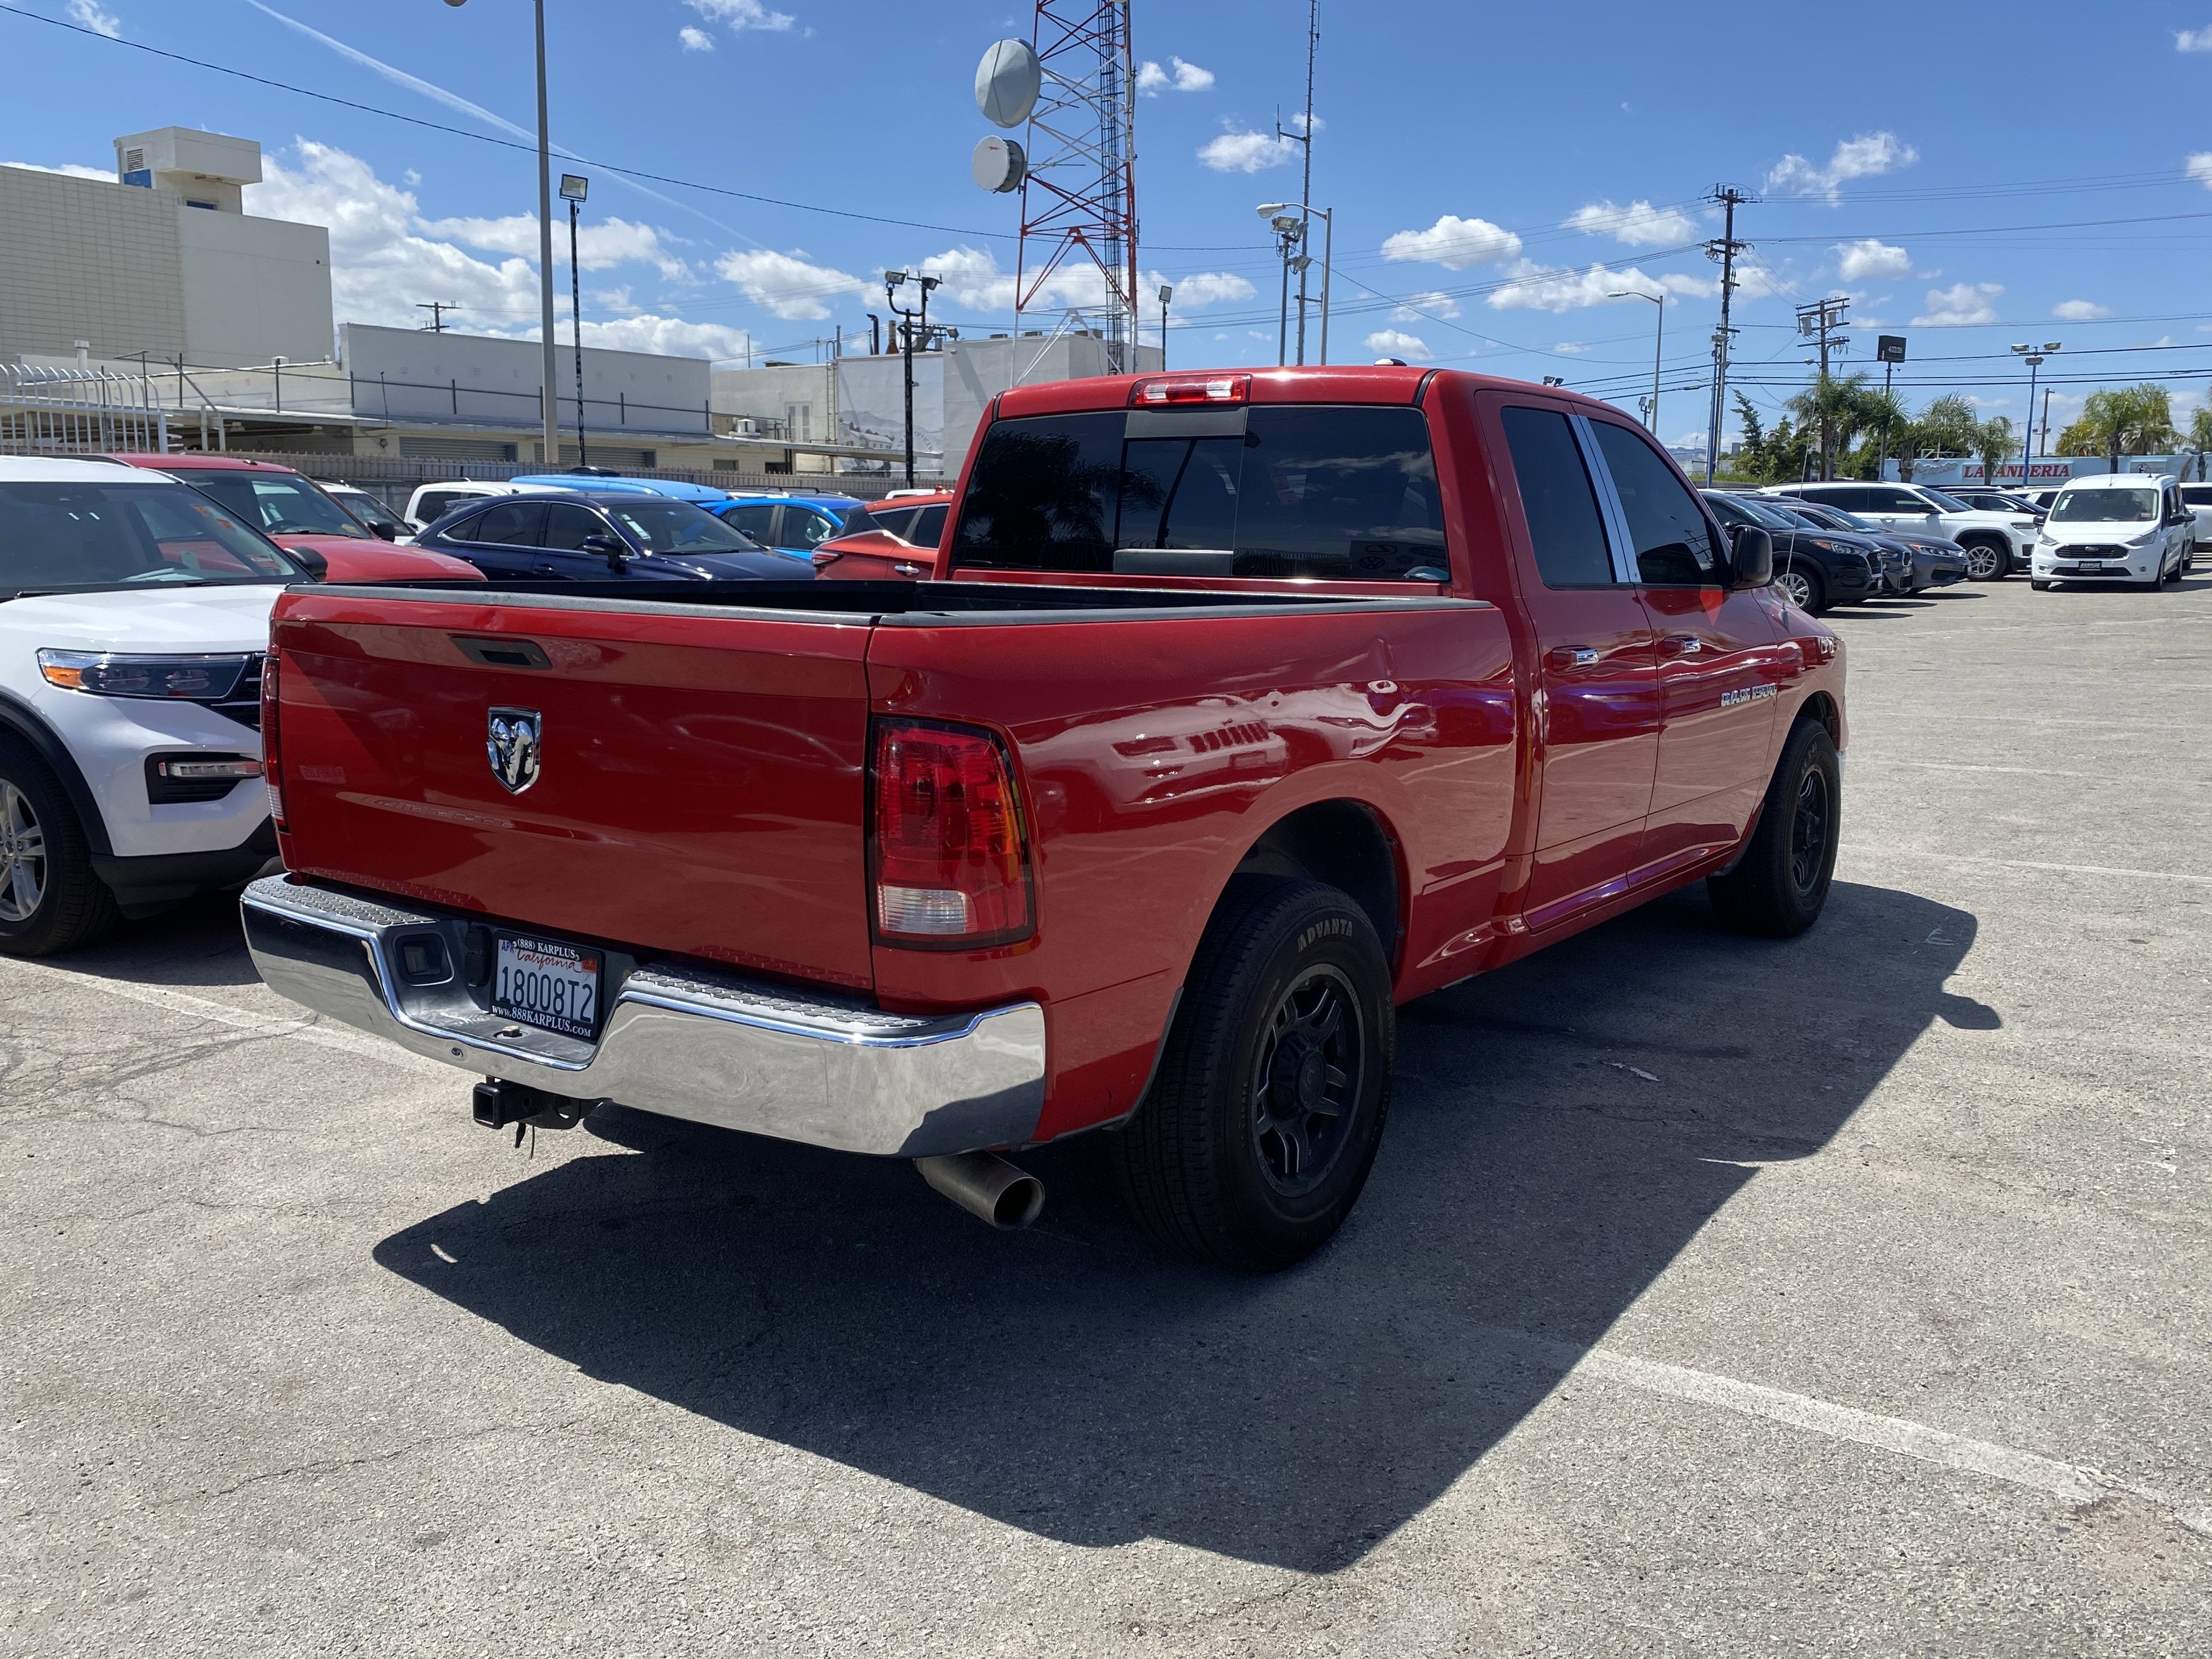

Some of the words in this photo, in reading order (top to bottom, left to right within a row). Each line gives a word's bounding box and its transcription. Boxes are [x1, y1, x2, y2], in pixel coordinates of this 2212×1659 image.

[1963, 465, 2070, 477] LAANDERIA
[1721, 687, 1751, 707] RAM
[1297, 918, 1353, 953] ADVANTA
[517, 938, 535, 950] (888)
[537, 942, 575, 959] KARPLUS
[517, 950, 583, 973] California
[499, 966, 593, 1023] 18008T2
